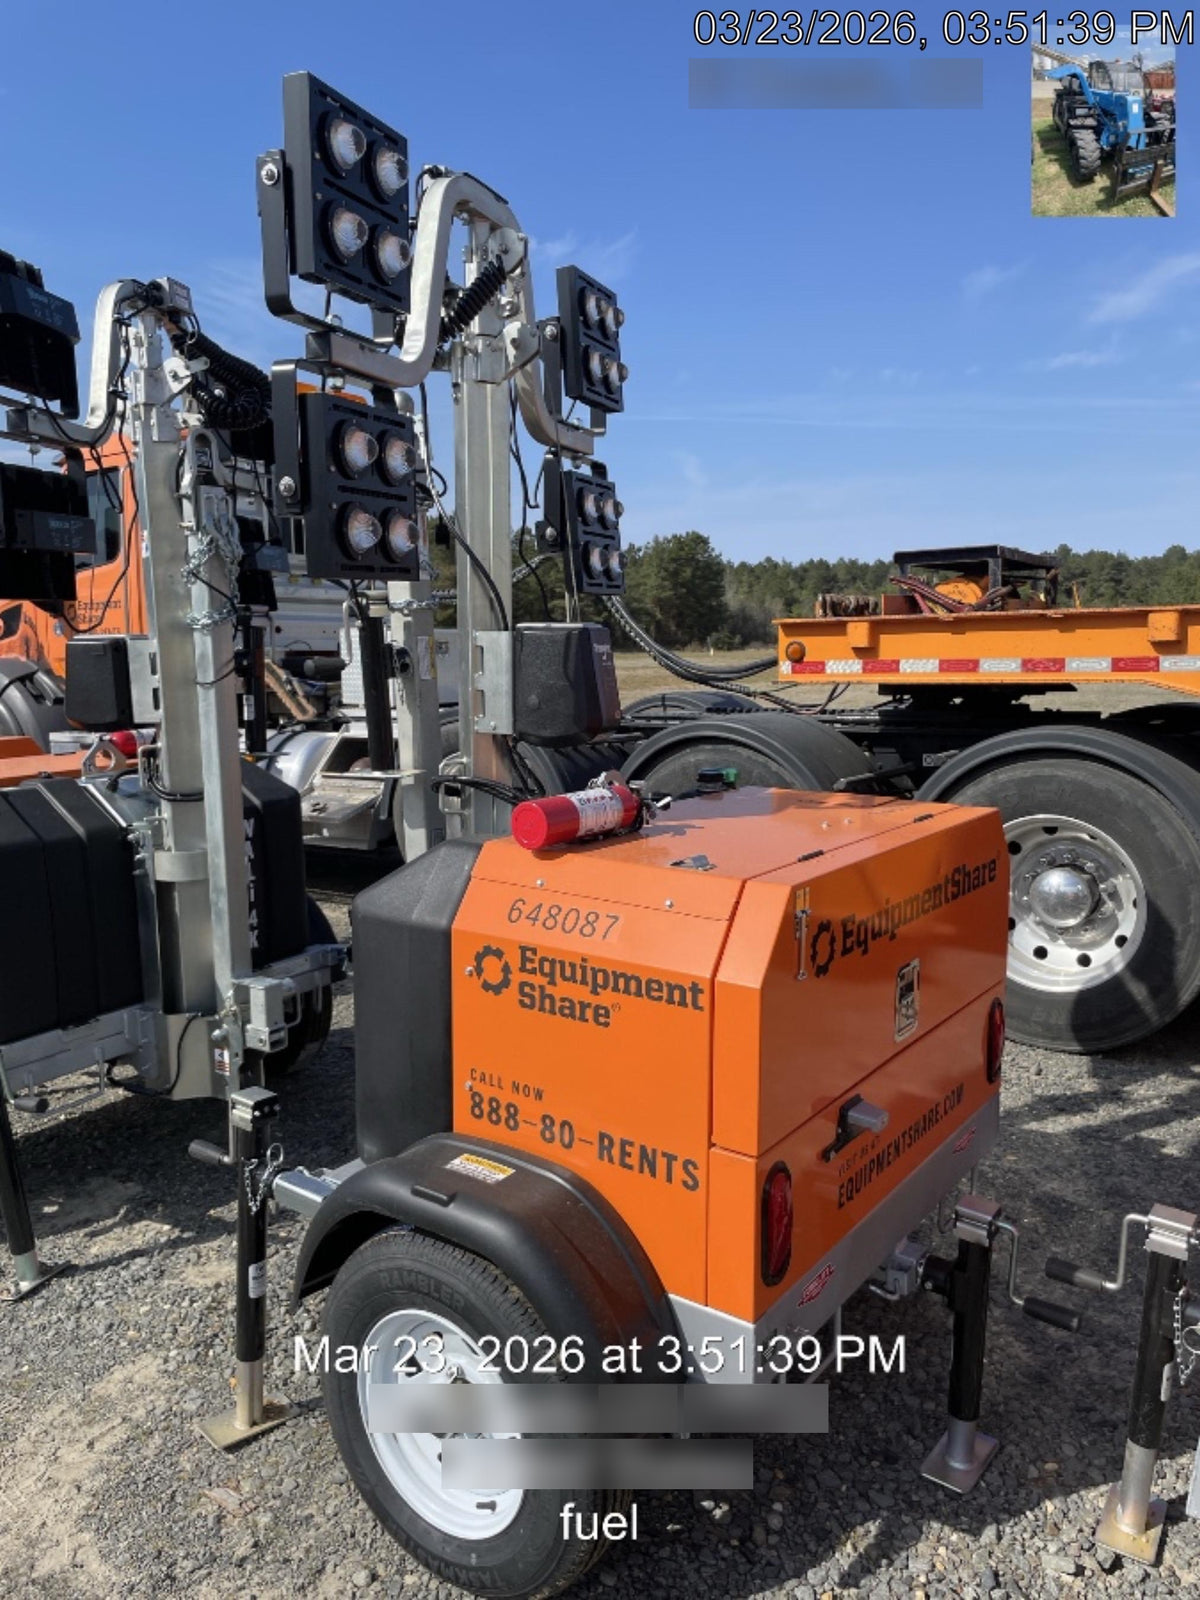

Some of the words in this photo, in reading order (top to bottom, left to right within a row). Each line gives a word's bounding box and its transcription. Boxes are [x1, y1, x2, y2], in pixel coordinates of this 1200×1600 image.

[507, 898, 620, 941] 648087
[840, 858, 997, 956] EquipmentShare
[518, 944, 705, 1012] Equipment
[470, 1067, 504, 1090] CALL
[511, 1080, 545, 1101] NOW
[470, 1091, 700, 1192] 888-80-RENTS
[838, 1083, 965, 1209] EQUIPMENTSHARE.COM
